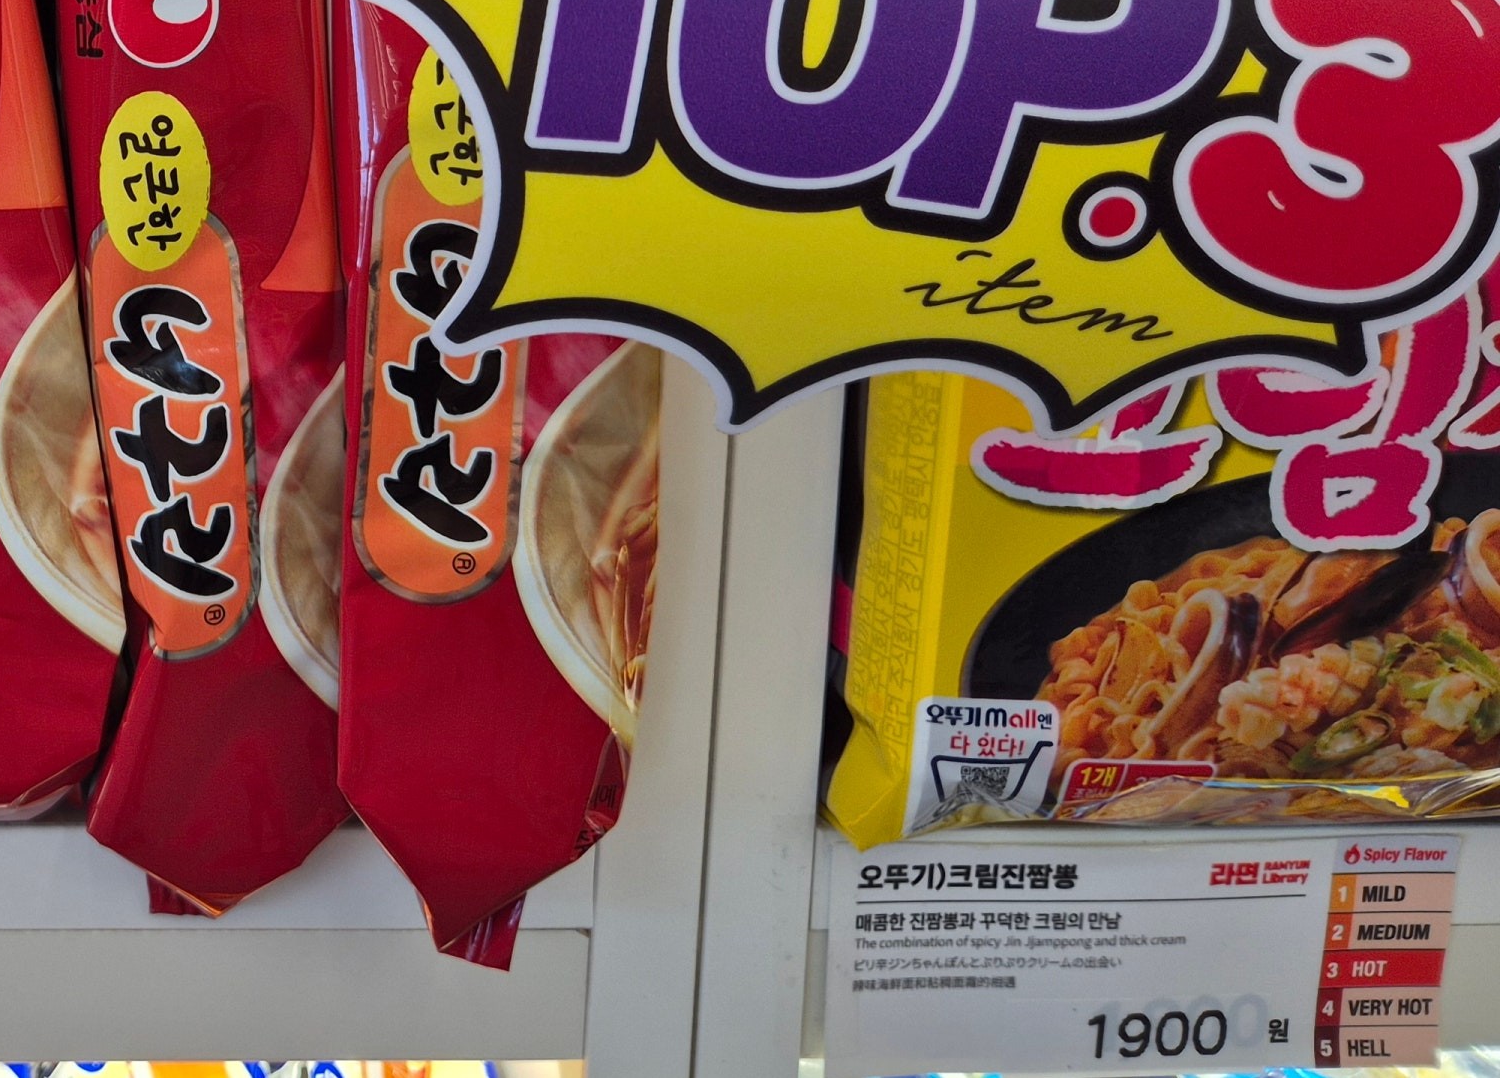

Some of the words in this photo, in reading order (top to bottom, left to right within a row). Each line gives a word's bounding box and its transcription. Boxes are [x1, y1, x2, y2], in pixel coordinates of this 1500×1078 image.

[430, 59, 484, 186] 큰한
[117, 113, 182, 253] 얼큰한
[902, 250, 1176, 345] item
[98, 284, 236, 603] 너구리
[950, 731, 970, 756] 다
[977, 732, 1025, 758] 있다!
[1080, 766, 1117, 787] 1개
[1363, 847, 1400, 865] Spicy
[1404, 845, 1449, 863] Flavor
[1209, 863, 1260, 887] 라면
[1263, 860, 1311, 872] RAMYUN
[857, 862, 1080, 892] 오뚜기)크림진짬뽕
[1262, 871, 1308, 886] Library
[1337, 885, 1348, 903] 1
[1361, 884, 1407, 904] MILD
[855, 912, 906, 932] 매콤한
[910, 912, 976, 931] 진짬뽕과
[980, 912, 1031, 931] 꾸덕한
[1033, 911, 1084, 931] 크림의
[1088, 911, 1122, 930] 만남
[855, 937, 877, 950] The
[879, 937, 954, 950] combination
[956, 935, 969, 948] of
[971, 935, 1002, 951] spicy
[1004, 935, 1022, 948] Jin
[1094, 934, 1117, 947] and
[1119, 934, 1148, 947] thick
[1150, 935, 1187, 947] cream
[1331, 923, 1345, 942] 2
[1357, 922, 1431, 943] MEDIUM
[1325, 961, 1339, 979] 3
[1352, 959, 1388, 979] HOT
[1321, 999, 1335, 1017] 4
[1348, 998, 1393, 1018] VERY
[1397, 998, 1434, 1018] HOT
[1088, 1009, 1230, 1061] 1900
[1268, 1017, 1291, 1046] 원
[1320, 1039, 1333, 1058] 5
[1347, 1039, 1391, 1059] HELL
